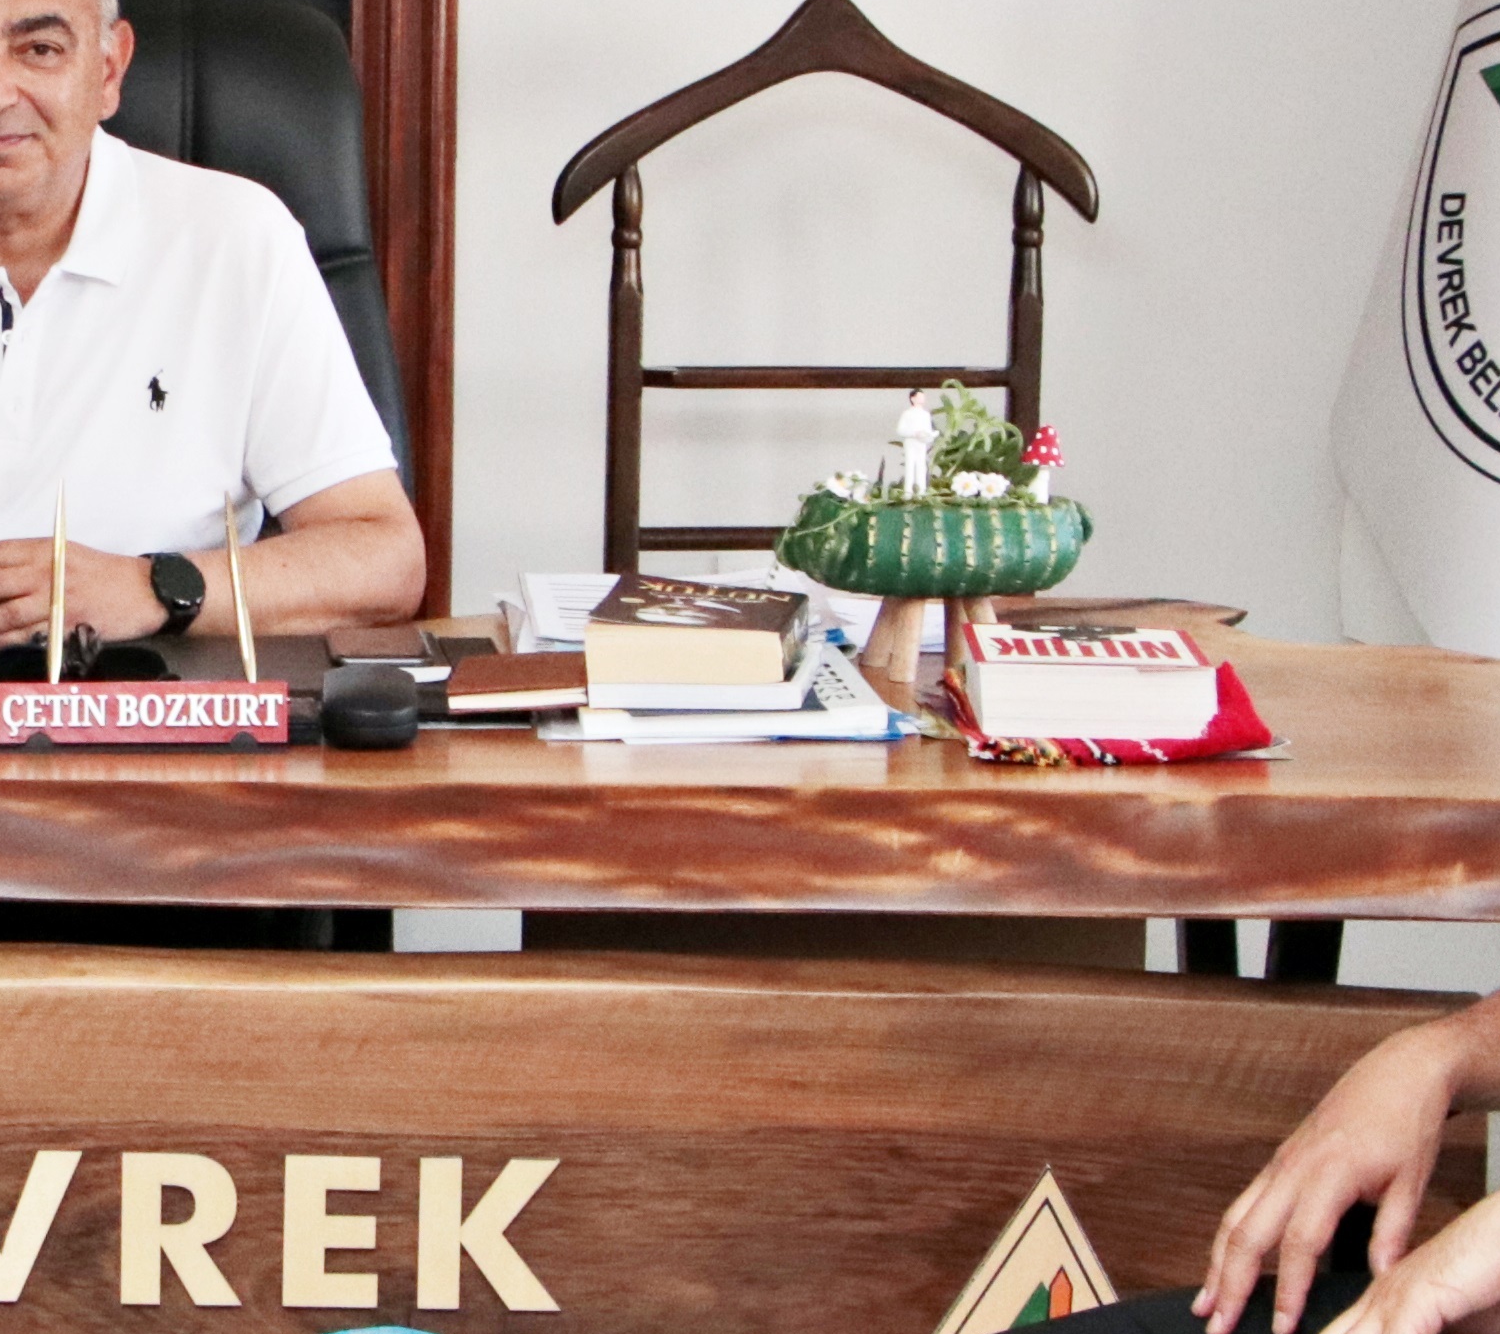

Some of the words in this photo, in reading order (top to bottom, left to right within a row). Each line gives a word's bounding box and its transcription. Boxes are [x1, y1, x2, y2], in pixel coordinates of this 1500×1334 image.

[1436, 192, 1475, 349] DEVREK
[2, 685, 108, 738] ÇETİN
[116, 693, 284, 728] BOZKURT
